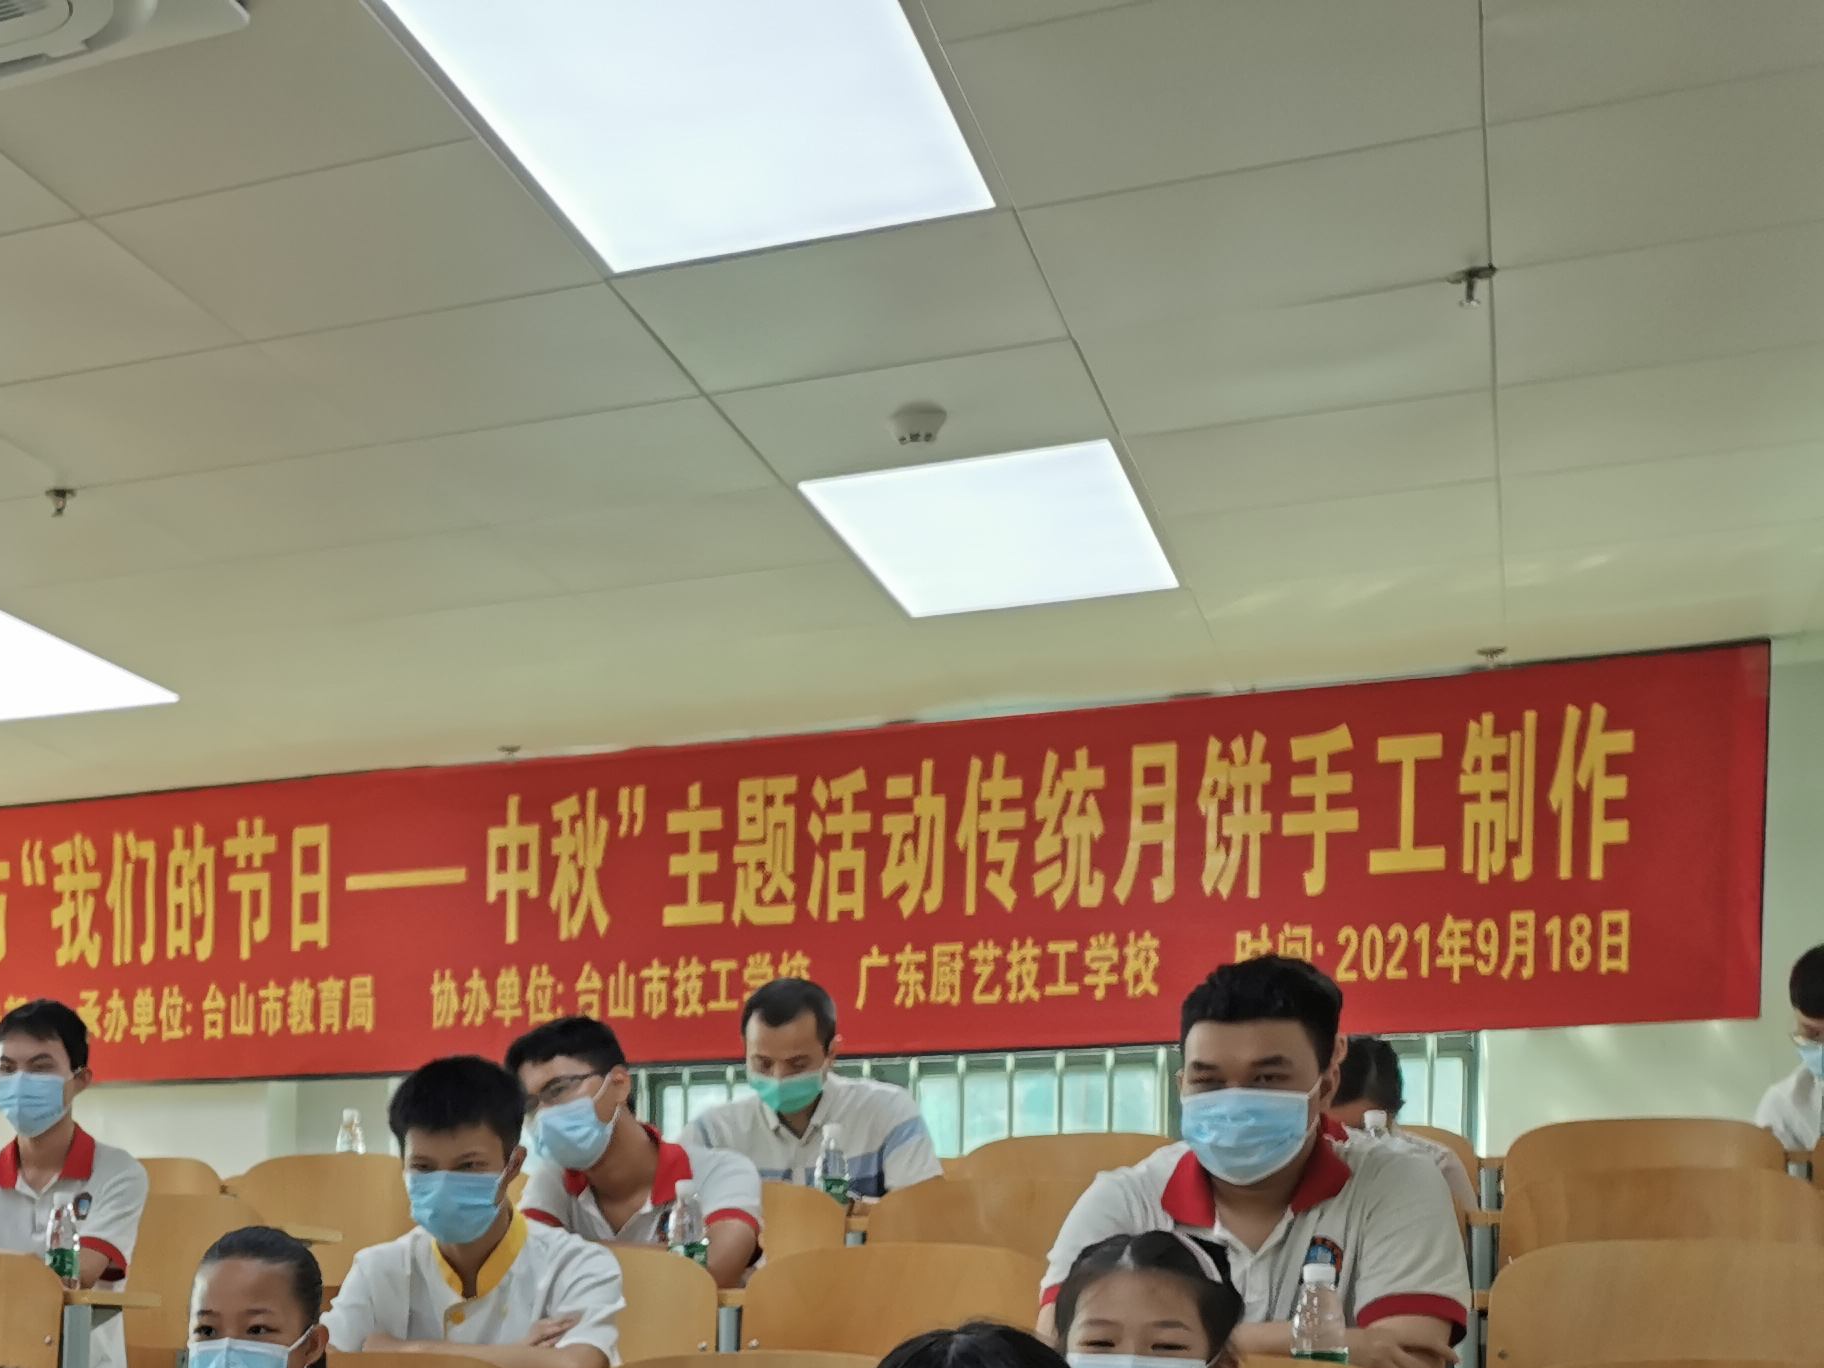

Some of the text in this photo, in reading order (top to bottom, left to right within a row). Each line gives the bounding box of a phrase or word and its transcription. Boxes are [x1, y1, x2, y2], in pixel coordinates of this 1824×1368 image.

[855, 930, 1159, 1010] 广东厨艺技工学校
